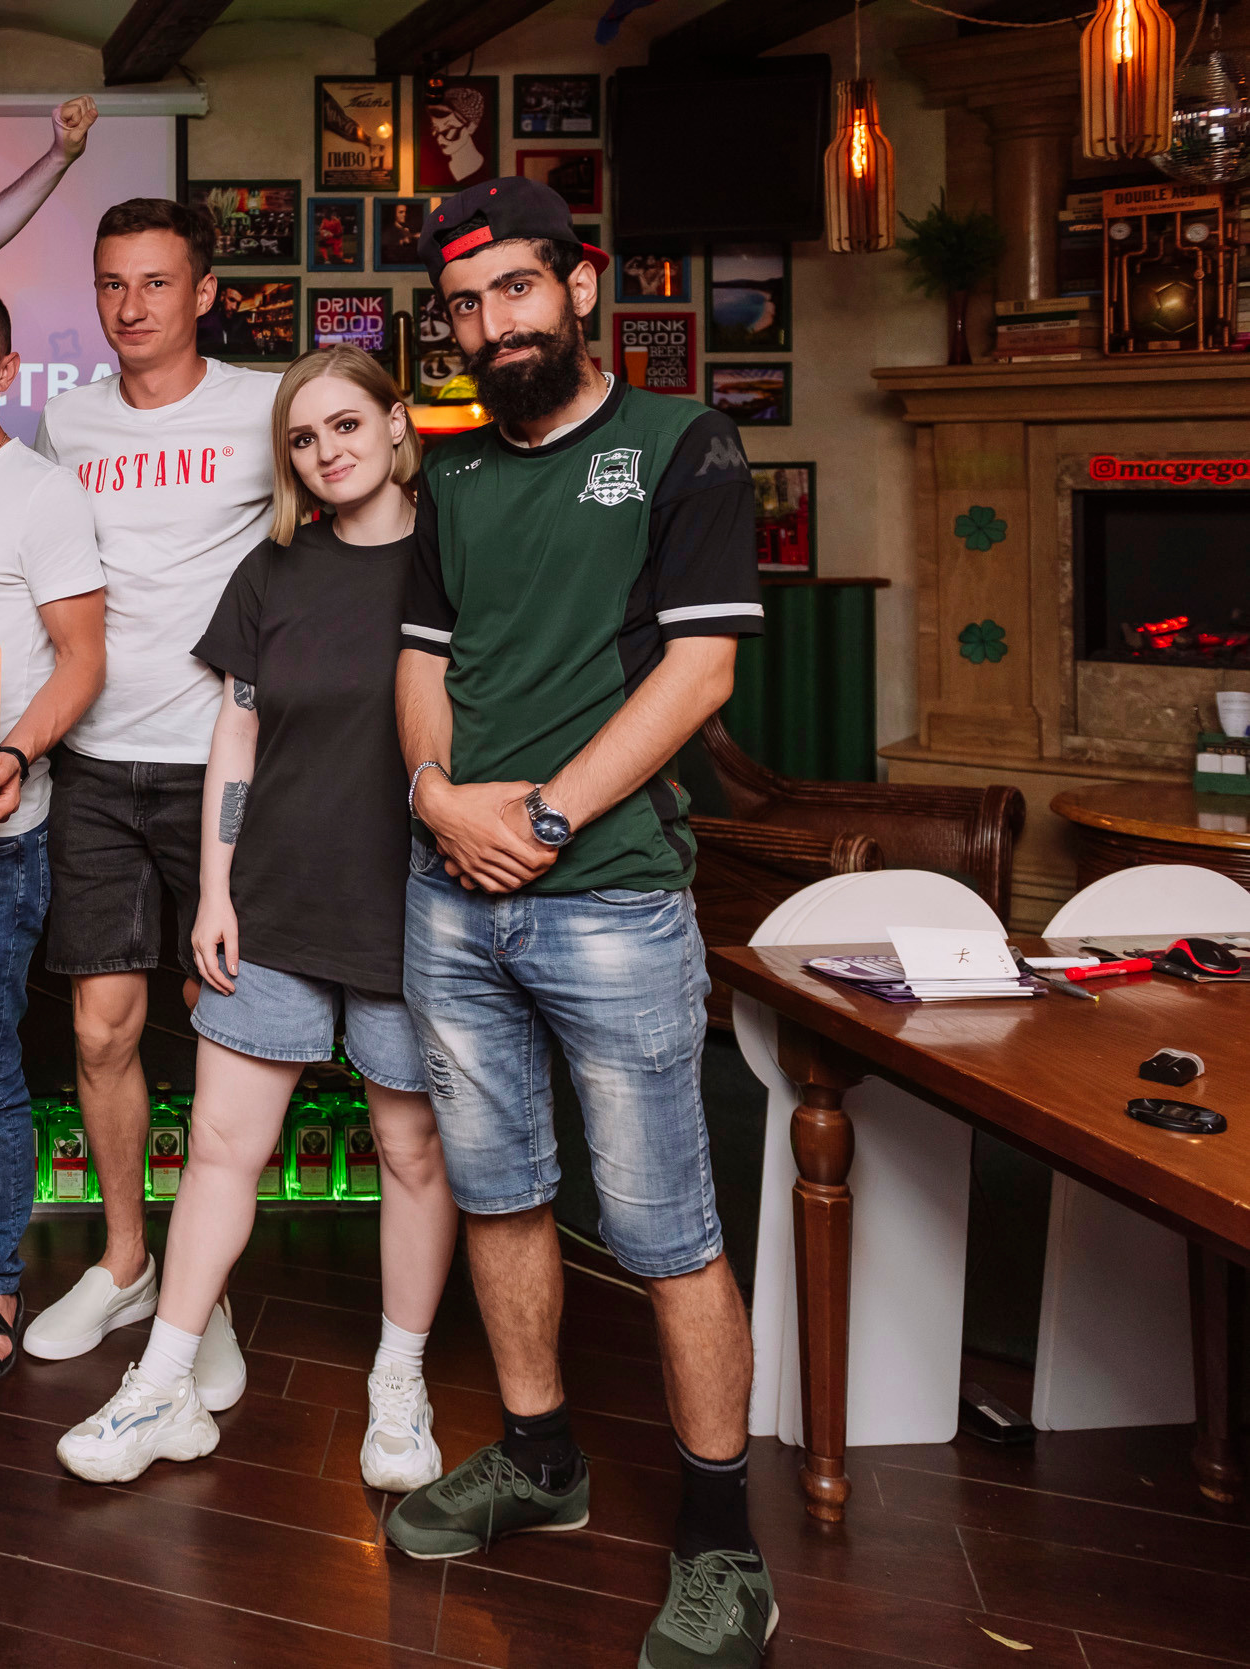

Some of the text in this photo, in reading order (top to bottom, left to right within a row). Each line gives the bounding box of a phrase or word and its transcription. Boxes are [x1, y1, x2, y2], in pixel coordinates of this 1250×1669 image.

[327, 151, 365, 168] ПИВО
[1114, 188, 1167, 205] DOUBLE
[317, 296, 383, 313] DRINK
[317, 314, 383, 333] GOOD
[623, 320, 685, 332] DRINK
[623, 332, 686, 345] GOOD
[649, 345, 686, 357] BEER
[647, 367, 687, 377] GOOD
[647, 376, 687, 387] FRIENDS
